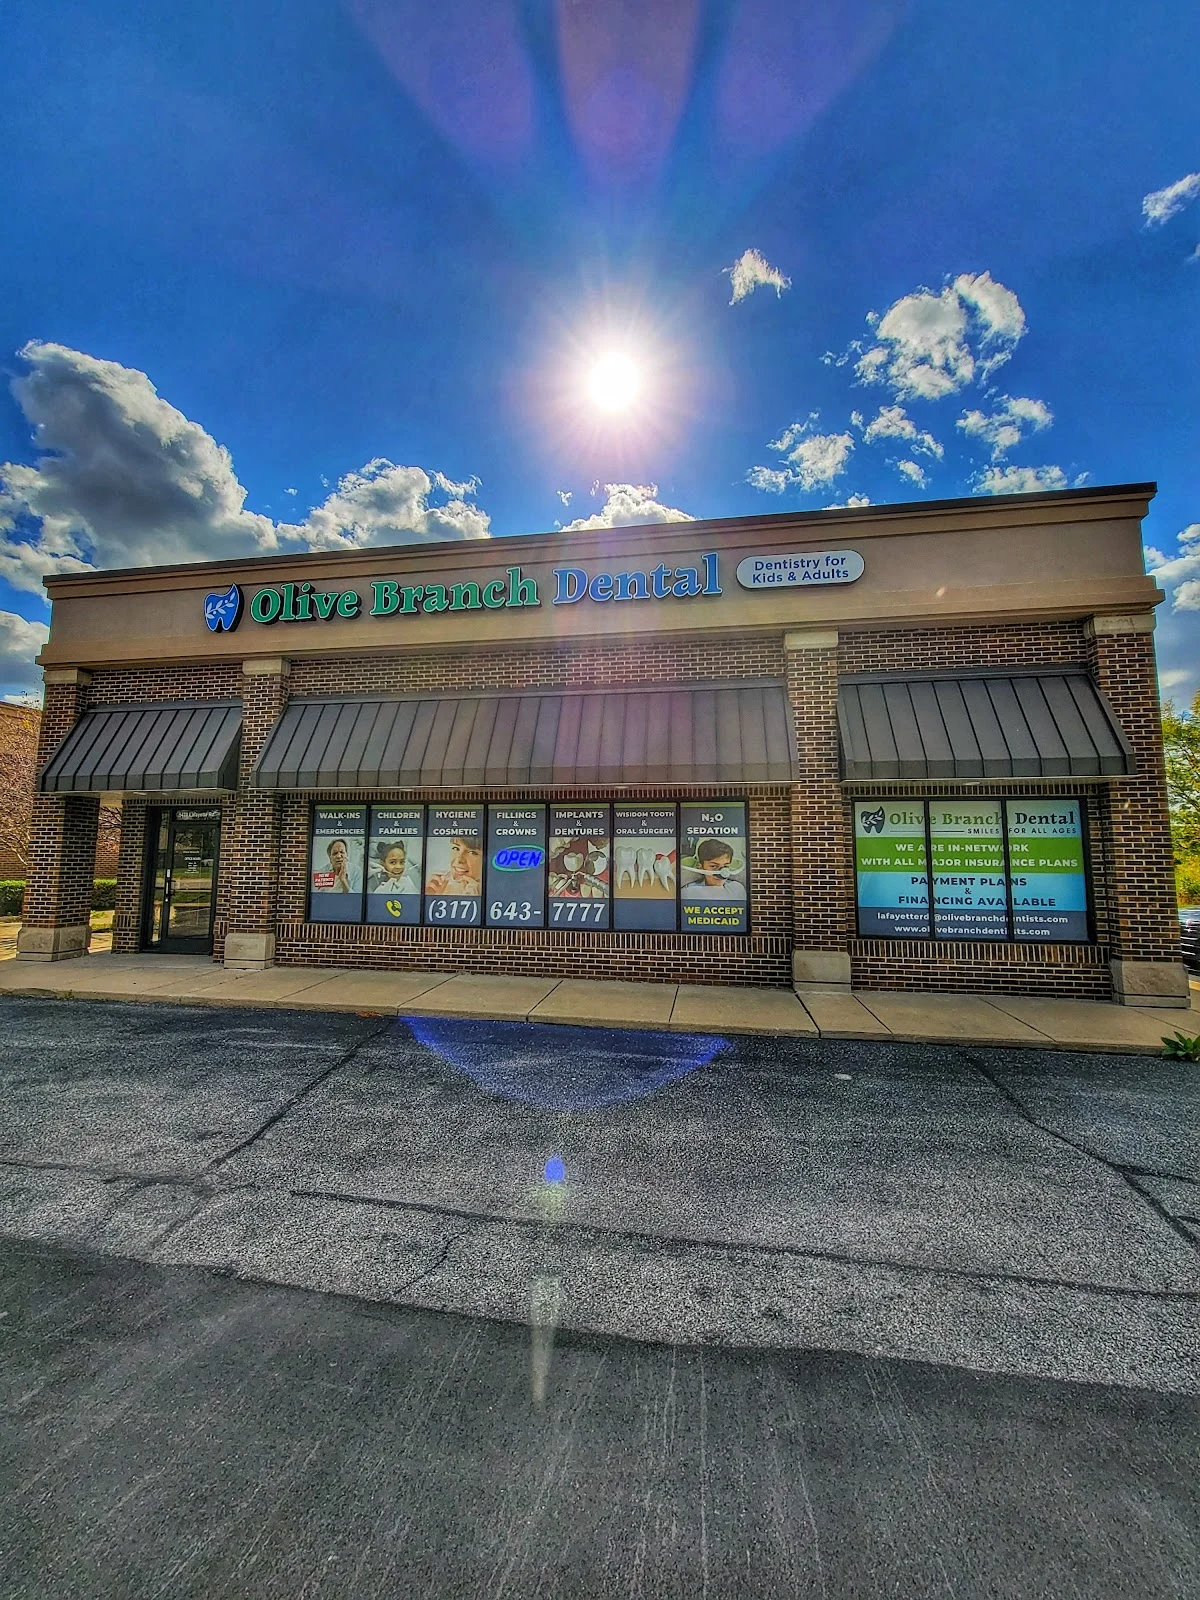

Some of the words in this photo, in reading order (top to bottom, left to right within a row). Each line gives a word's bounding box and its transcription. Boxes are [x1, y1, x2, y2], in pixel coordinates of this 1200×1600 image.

[755, 557, 821, 571] Dentistry
[825, 555, 846, 567] for
[752, 572, 783, 584] Kids
[787, 571, 797, 582] &
[801, 569, 849, 581] Adults
[250, 583, 359, 623] Olive
[370, 566, 540, 616] Branch
[552, 552, 723, 605] Dental
[436, 811, 476, 819] HYGIENE
[496, 811, 537, 819] FILLINGS
[555, 811, 604, 819] IMPLANTS
[889, 812, 937, 825] Olive
[941, 811, 1008, 825] Branch
[1014, 811, 1075, 825] Dental
[687, 827, 739, 835] SEDATION
[896, 843, 914, 851] WE
[918, 844, 944, 852] ARE
[948, 844, 1029, 852] IN-NETWORK
[496, 850, 542, 867] OPEN
[861, 858, 890, 866] WITH
[894, 858, 914, 866] ALL
[918, 858, 961, 867] MAJOR
[965, 858, 1035, 867] INSURANCE
[1039, 858, 1078, 867] PLANS
[911, 876, 976, 886] PAYMENT
[980, 877, 1027, 886] PLANS
[898, 896, 973, 905] FINANCING
[428, 900, 478, 922] (317)
[489, 901, 541, 921] 643-
[552, 902, 606, 922] 7777
[683, 906, 701, 914] WE
[703, 907, 744, 915] ACCEPT
[687, 917, 740, 925] MEDICAID
